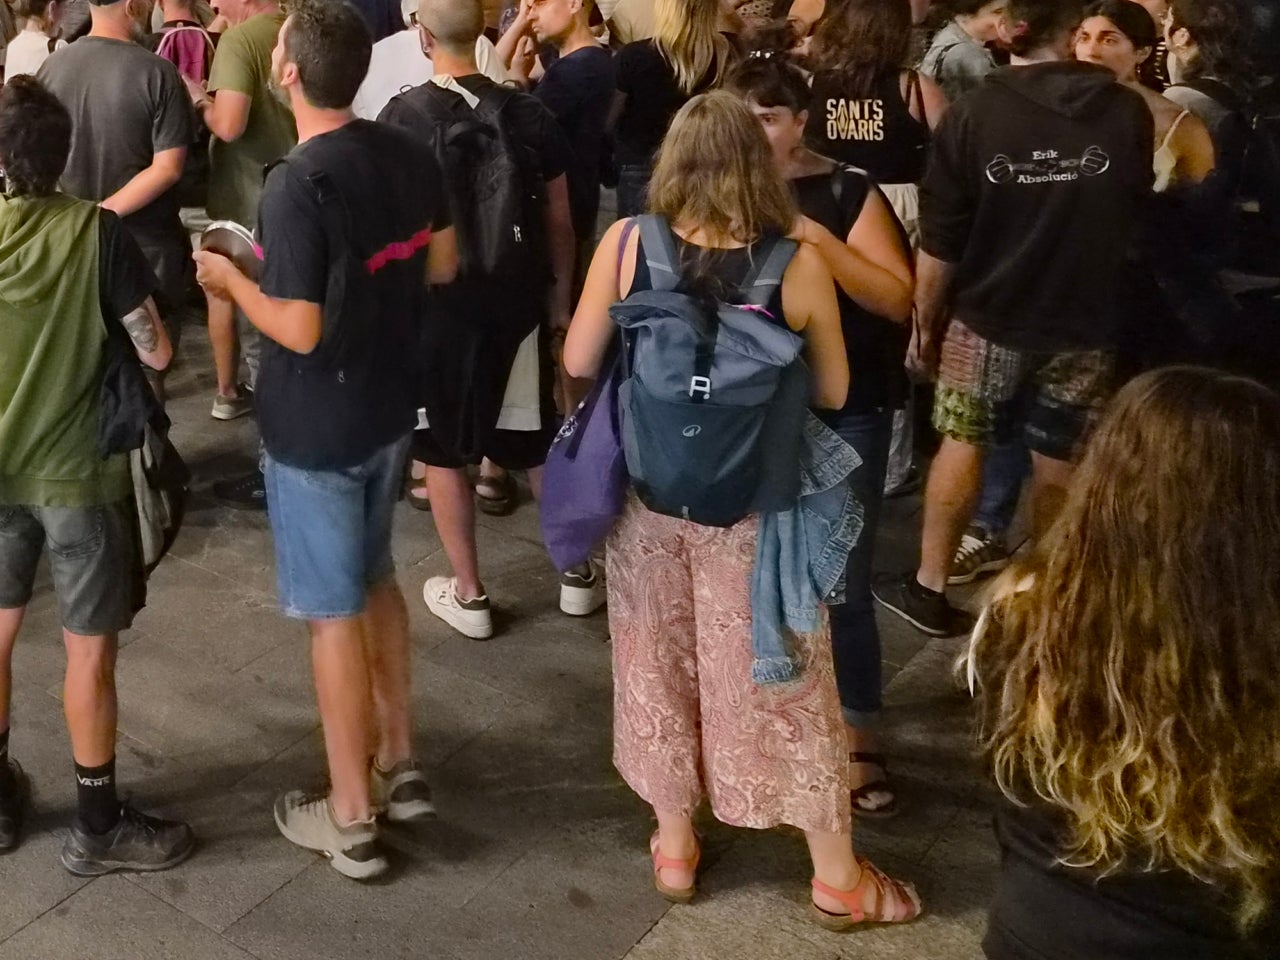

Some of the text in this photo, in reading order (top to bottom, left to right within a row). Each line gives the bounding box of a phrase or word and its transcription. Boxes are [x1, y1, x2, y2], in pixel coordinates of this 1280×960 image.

[826, 98, 883, 120] SANTS
[826, 119, 884, 141] OVARIS
[1032, 149, 1059, 160] Erik
[1016, 170, 1078, 184] Absolució
